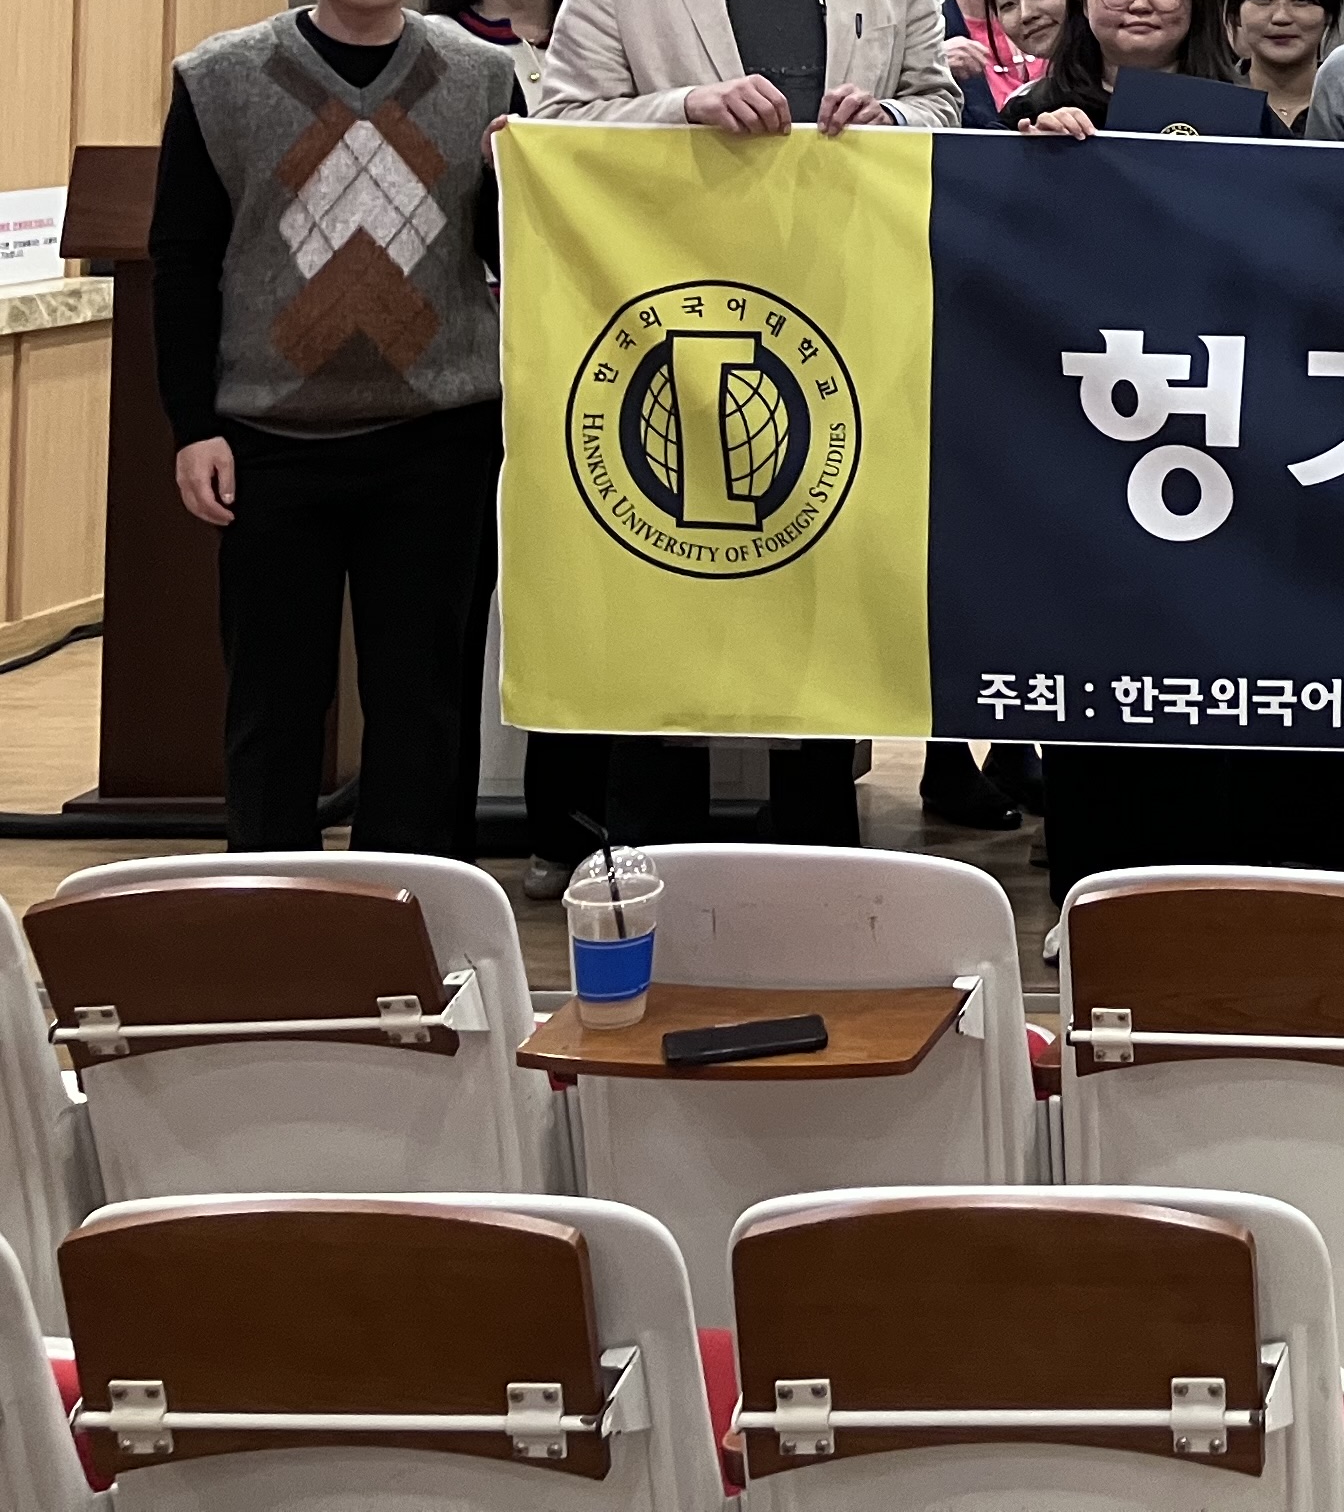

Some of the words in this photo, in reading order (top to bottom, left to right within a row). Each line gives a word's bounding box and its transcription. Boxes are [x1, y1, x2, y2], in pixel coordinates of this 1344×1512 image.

[593, 296, 839, 400] 한국외국어대학교
[582, 413, 618, 501] HANKUK
[611, 496, 720, 563] UNIVERSITY
[725, 545, 750, 563] OF
[752, 502, 820, 558] FOREIGN
[808, 422, 846, 504] STUDIES
[978, 674, 1065, 721] 주최
